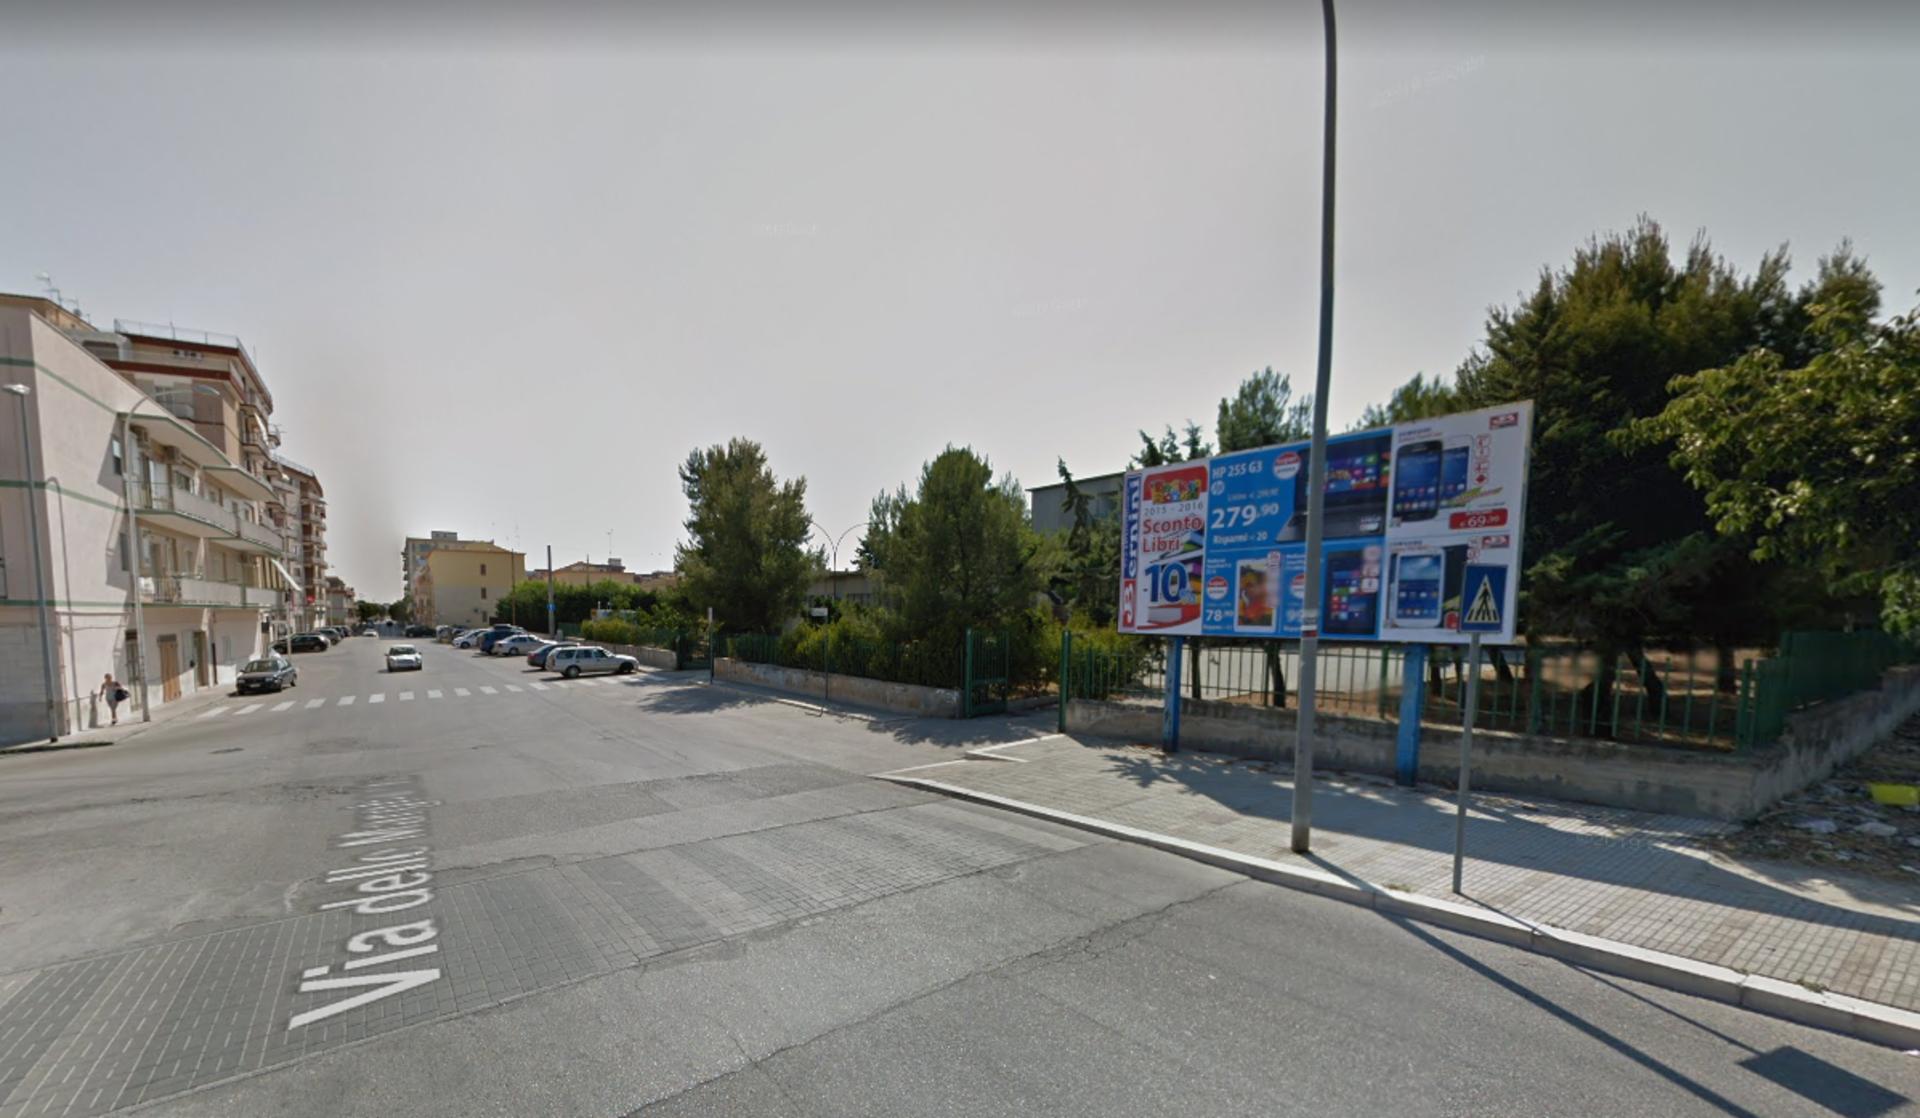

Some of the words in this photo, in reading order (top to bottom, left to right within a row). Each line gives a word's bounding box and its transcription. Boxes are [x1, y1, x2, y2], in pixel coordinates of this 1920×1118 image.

[1227, 462, 1247, 478] 255
[1143, 516, 1203, 535] Sconto
[1143, 536, 1180, 553] Libri
